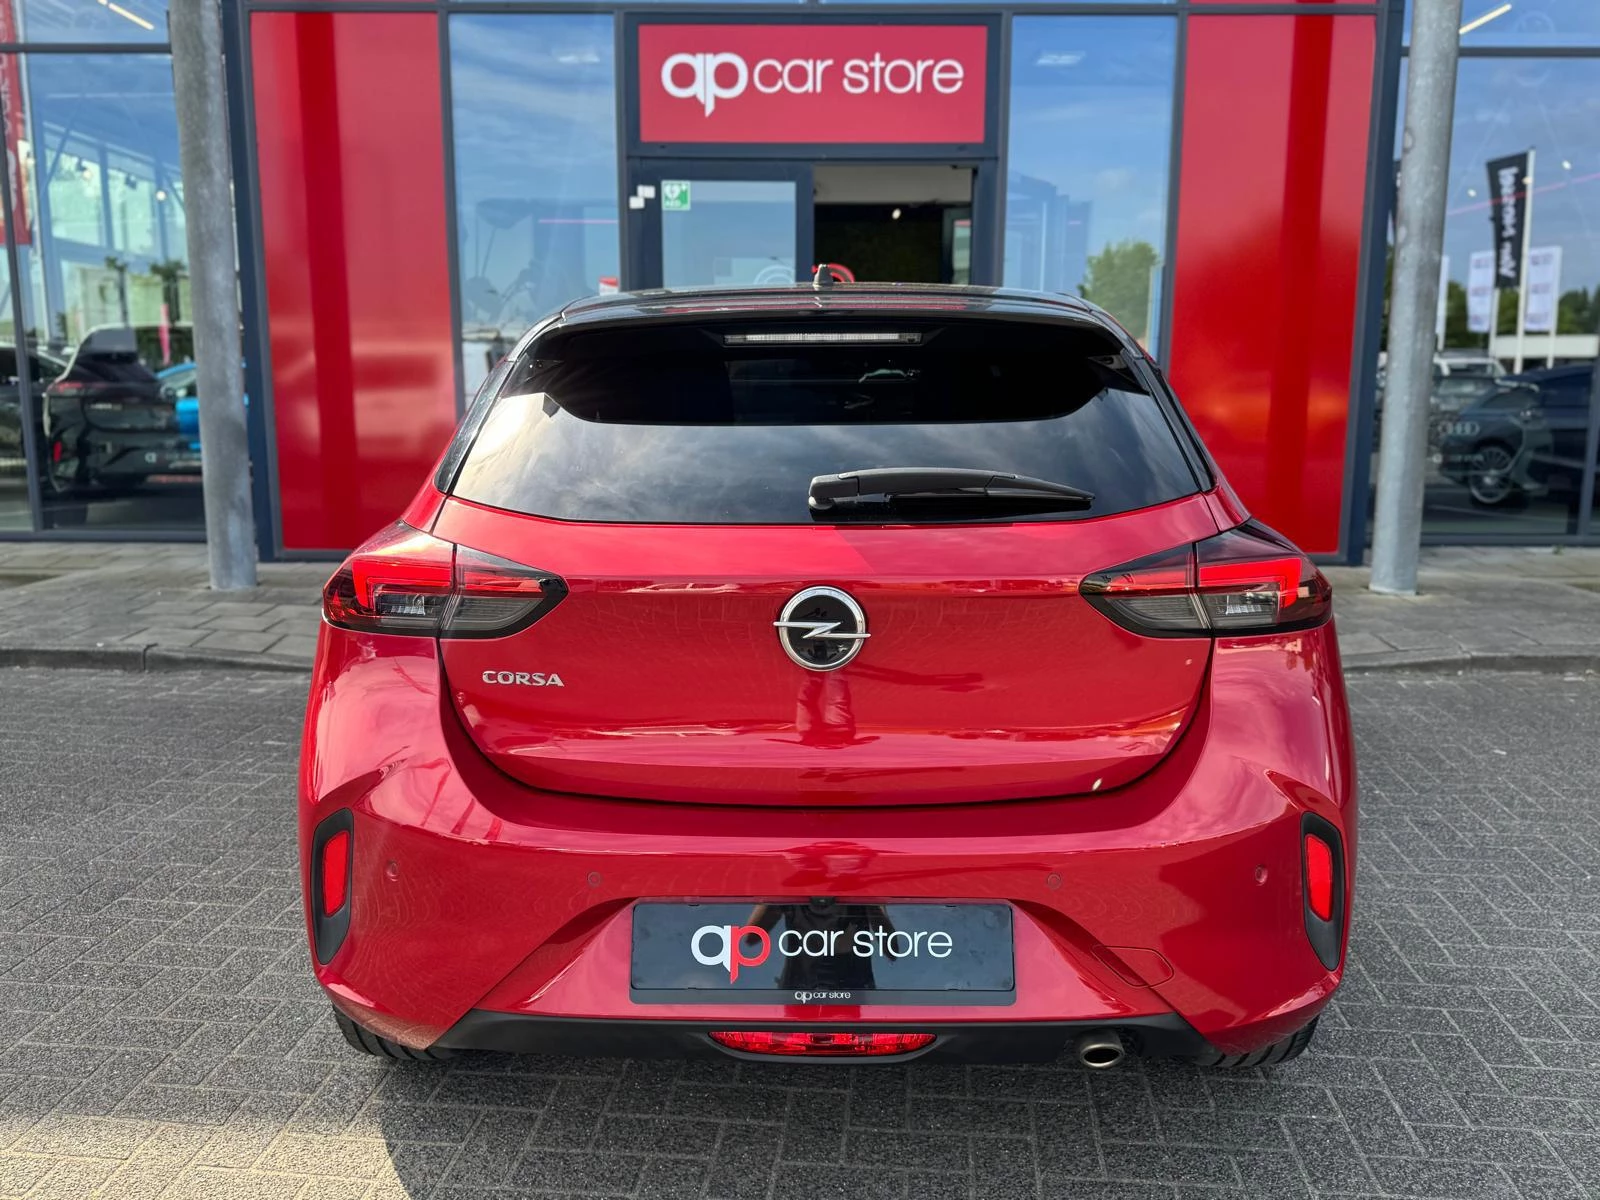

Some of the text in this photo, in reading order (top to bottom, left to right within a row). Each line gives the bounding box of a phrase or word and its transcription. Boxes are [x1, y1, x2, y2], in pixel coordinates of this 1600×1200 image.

[661, 52, 965, 118] ap car store
[482, 670, 565, 687] CORSA
[691, 925, 953, 984] ap car store
[828, 991, 851, 999] store
